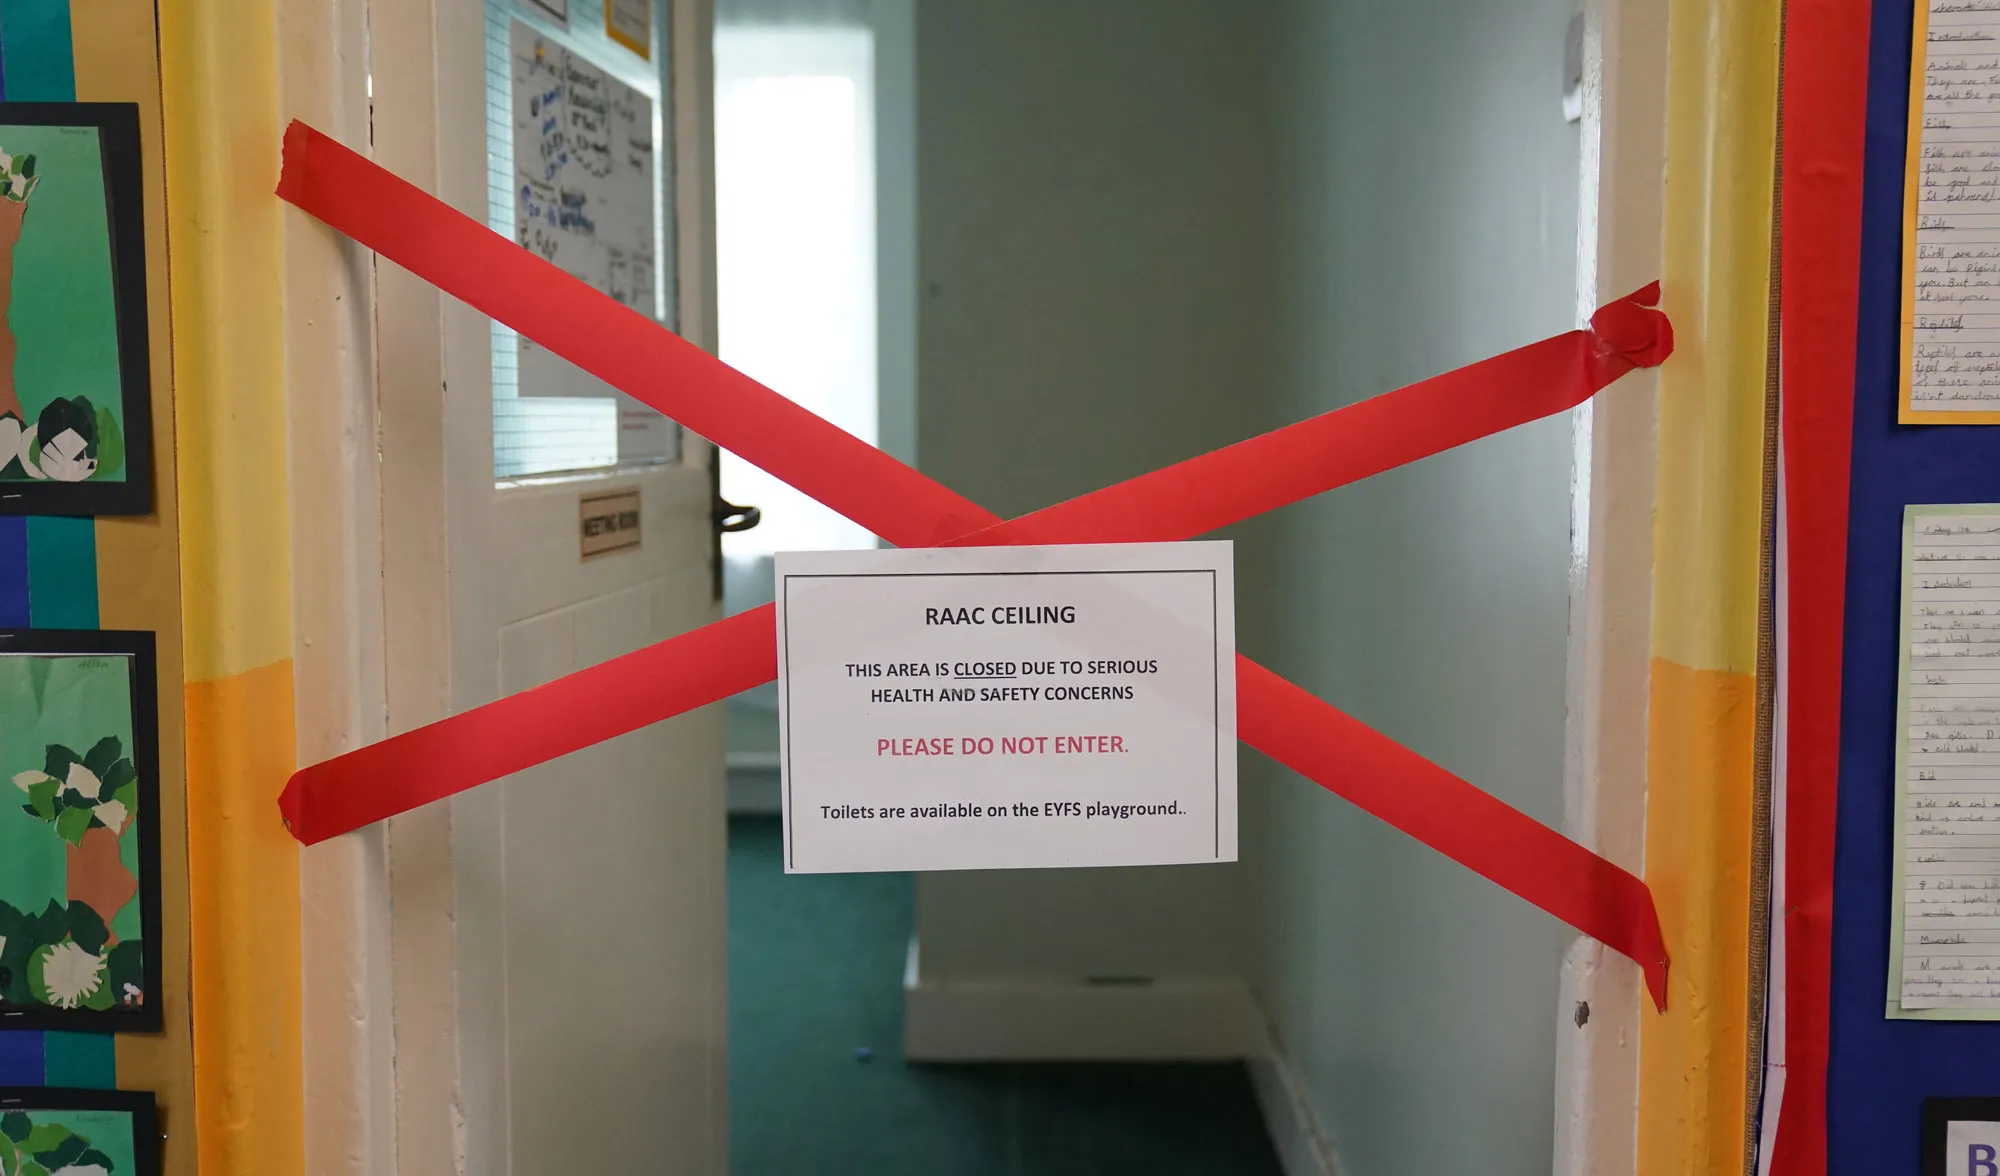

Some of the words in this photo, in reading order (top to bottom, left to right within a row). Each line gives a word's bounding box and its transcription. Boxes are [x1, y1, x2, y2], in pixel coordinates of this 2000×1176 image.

[925, 606, 986, 626] RAAC
[991, 605, 1076, 625] CEILING
[844, 663, 882, 678] THIS
[886, 663, 931, 677] AREA
[935, 662, 950, 677] IS
[953, 661, 1018, 680] CLOSED
[1021, 661, 1056, 675] DUE
[1059, 660, 1083, 675] TO
[1087, 659, 1158, 675] SERIOUS
[871, 688, 934, 703] HEALTH
[938, 687, 976, 703] AND
[980, 687, 1040, 702] SAFETY
[1044, 685, 1134, 701] CONCERNS
[877, 738, 954, 756] PLEASE
[961, 738, 994, 755] DO
[1001, 736, 1048, 755] NOT
[1055, 736, 1129, 754] ENTER.
[820, 804, 875, 820] Toilets
[879, 807, 906, 819] are
[910, 802, 982, 818] available
[987, 805, 1008, 817] on
[1011, 802, 1039, 817] the
[1044, 801, 1082, 817] EYFS
[1086, 799, 1187, 820] playground..
